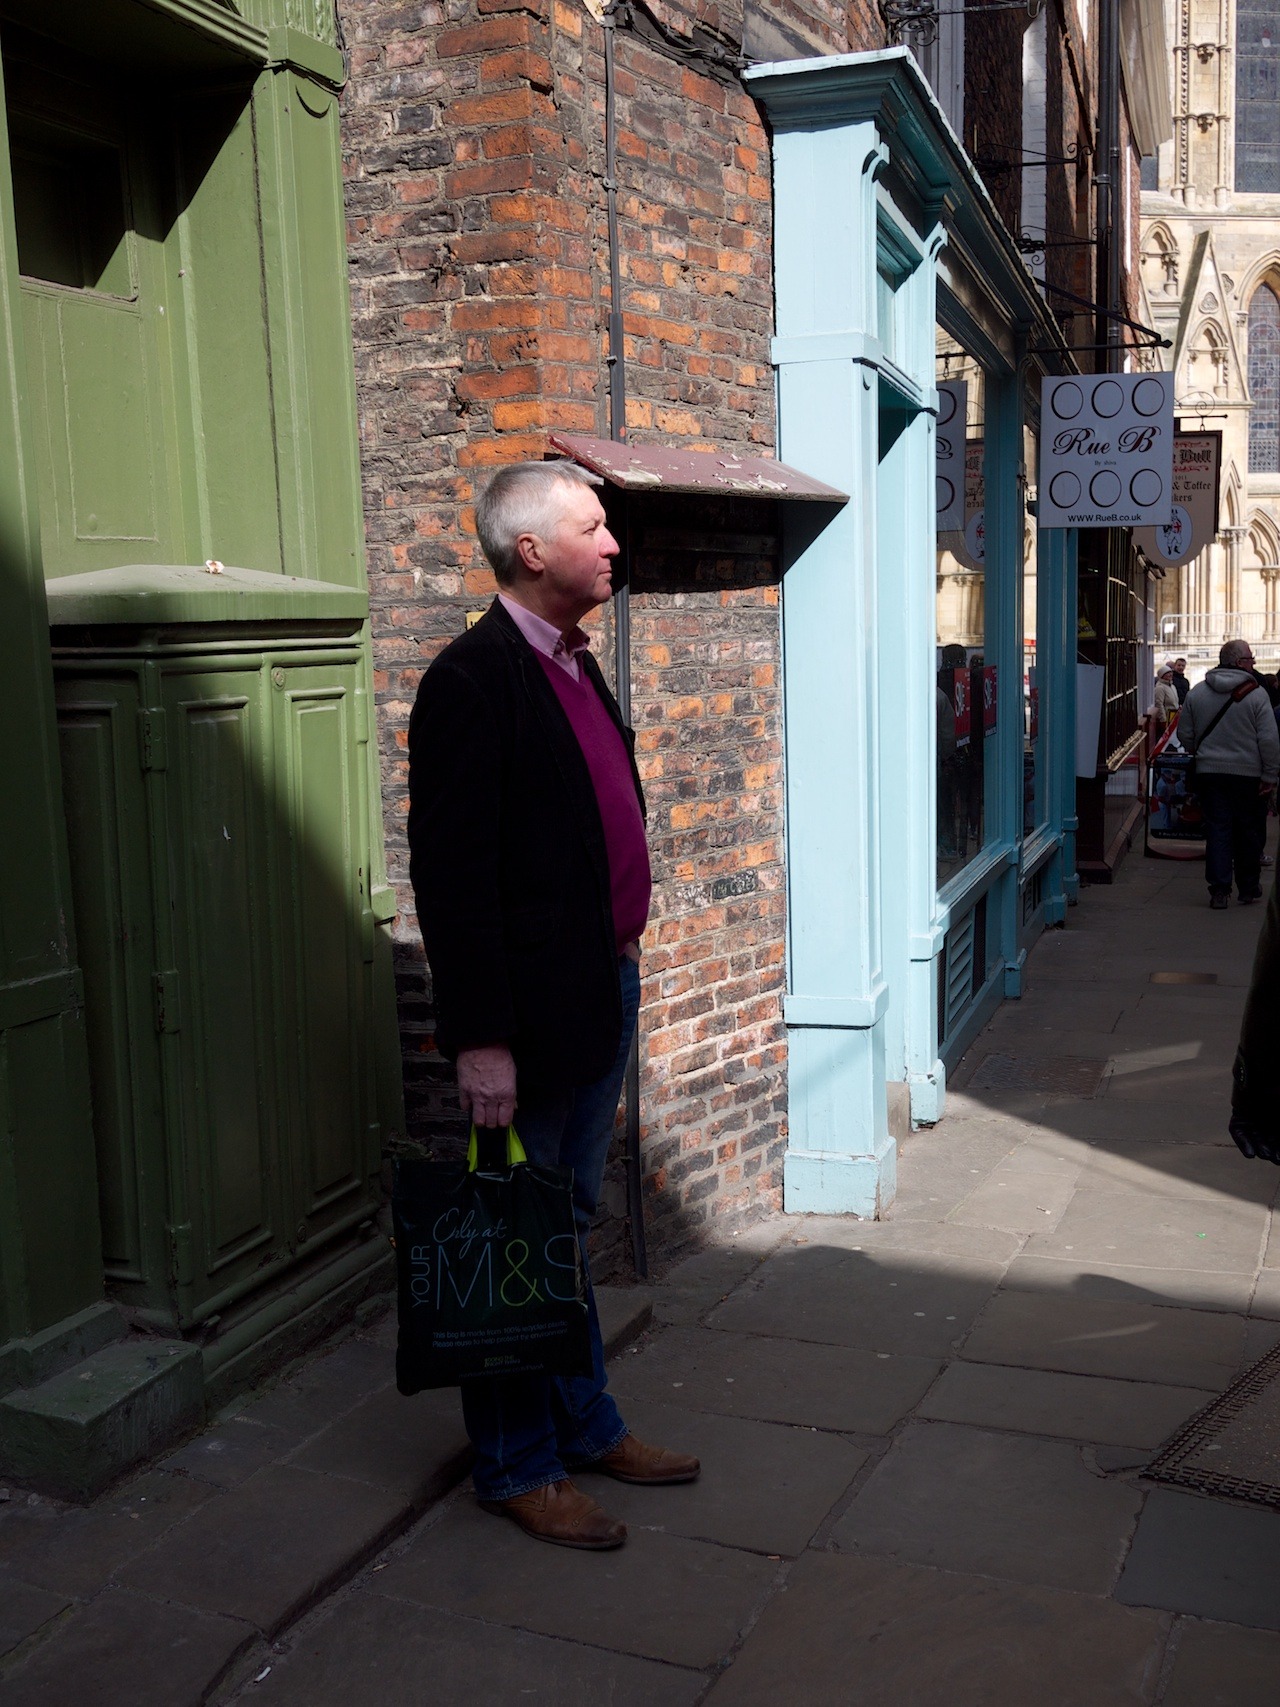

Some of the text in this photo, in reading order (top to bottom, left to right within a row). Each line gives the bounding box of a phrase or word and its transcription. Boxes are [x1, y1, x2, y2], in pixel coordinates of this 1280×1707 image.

[1052, 425, 1162, 455] Rue B
[1183, 481, 1211, 490] Toffee
[1172, 494, 1192, 503] kers
[433, 1207, 508, 1260] Only at
[411, 1245, 430, 1308] YOUR
[436, 1234, 577, 1310] M&S
[432, 1340, 453, 1348] Please
[481, 1337, 496, 1345] help
[496, 1335, 519, 1343] protect
[446, 1331, 459, 1340] bag
[467, 1329, 485, 1337] made
[487, 1327, 502, 1336] from
[504, 1326, 521, 1334] 100%
